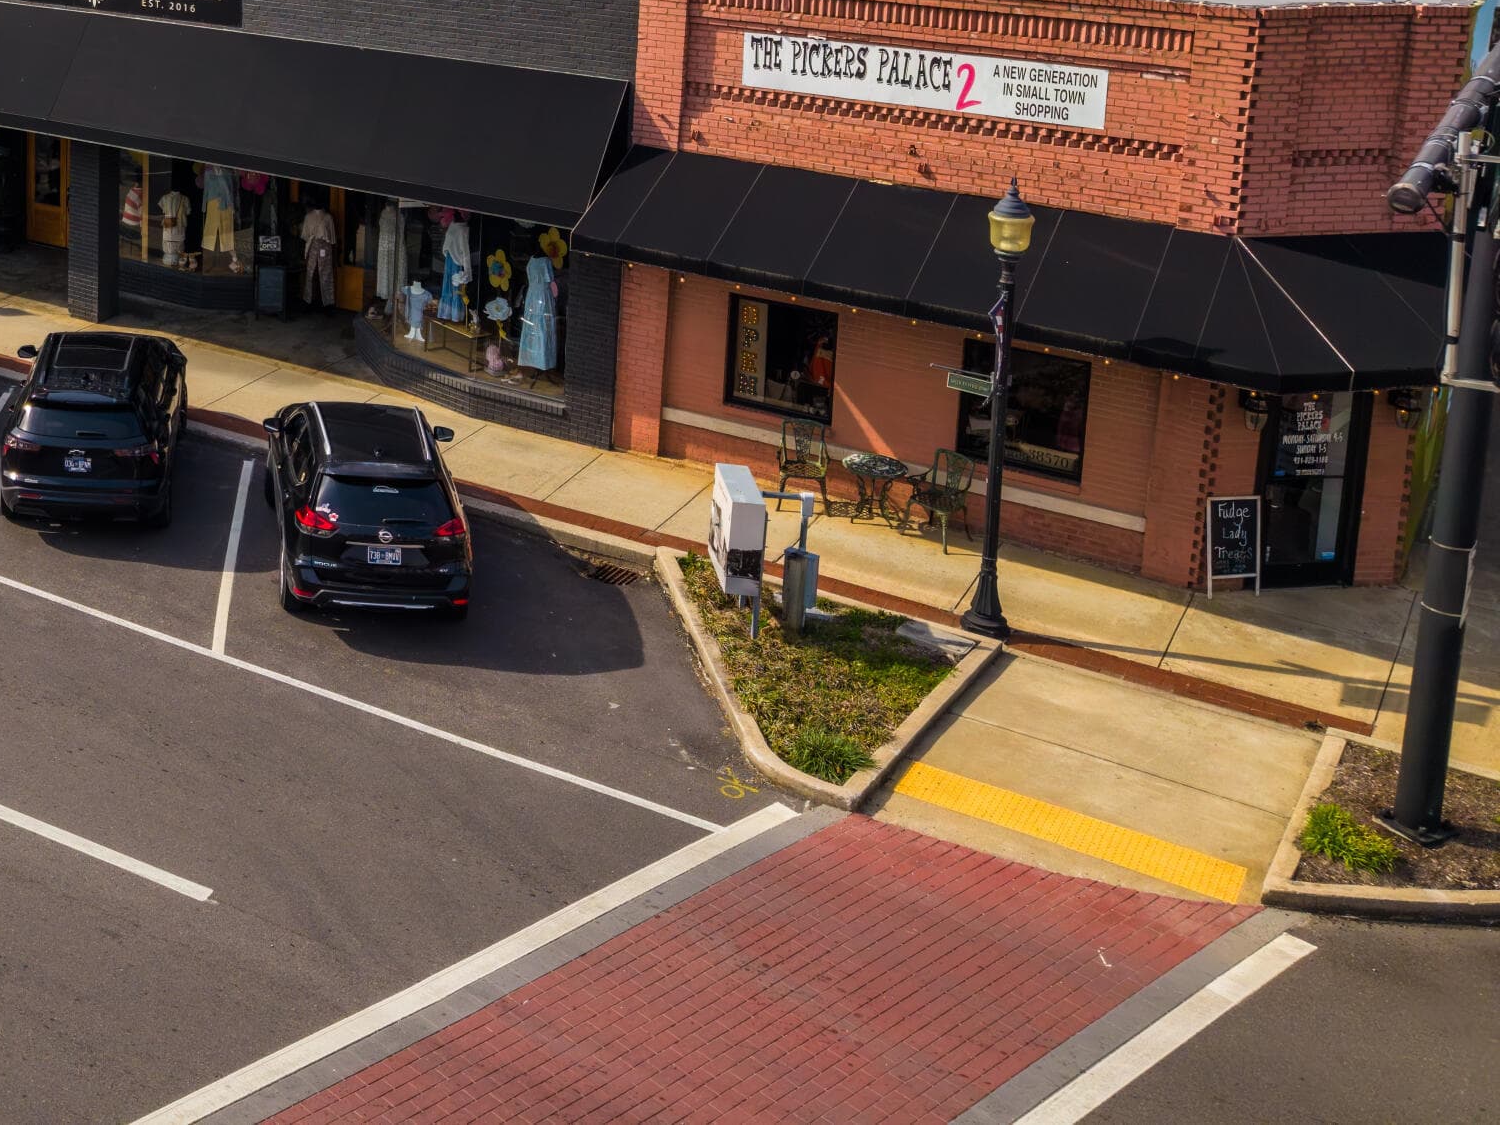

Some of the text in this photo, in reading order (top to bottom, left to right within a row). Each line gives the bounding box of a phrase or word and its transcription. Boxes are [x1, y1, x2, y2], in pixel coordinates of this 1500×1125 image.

[169, 2, 196, 13] 2016
[751, 35, 982, 111] THE PICKERS PALACE 2
[993, 65, 1098, 88] A NEW GENERATION
[1003, 82, 1086, 105] IN SMALL TOWN
[1015, 101, 1069, 121] SHOPPING
[740, 306, 758, 395] OPEN
[1297, 411, 1323, 421] PICKERS
[1304, 402, 1316, 411] THE
[1298, 421, 1322, 431] PALACE
[1028, 449, 1069, 469] 38570
[1218, 501, 1250, 525] Fudge
[1222, 524, 1247, 547] Lady
[1214, 546, 1253, 560] Treats
